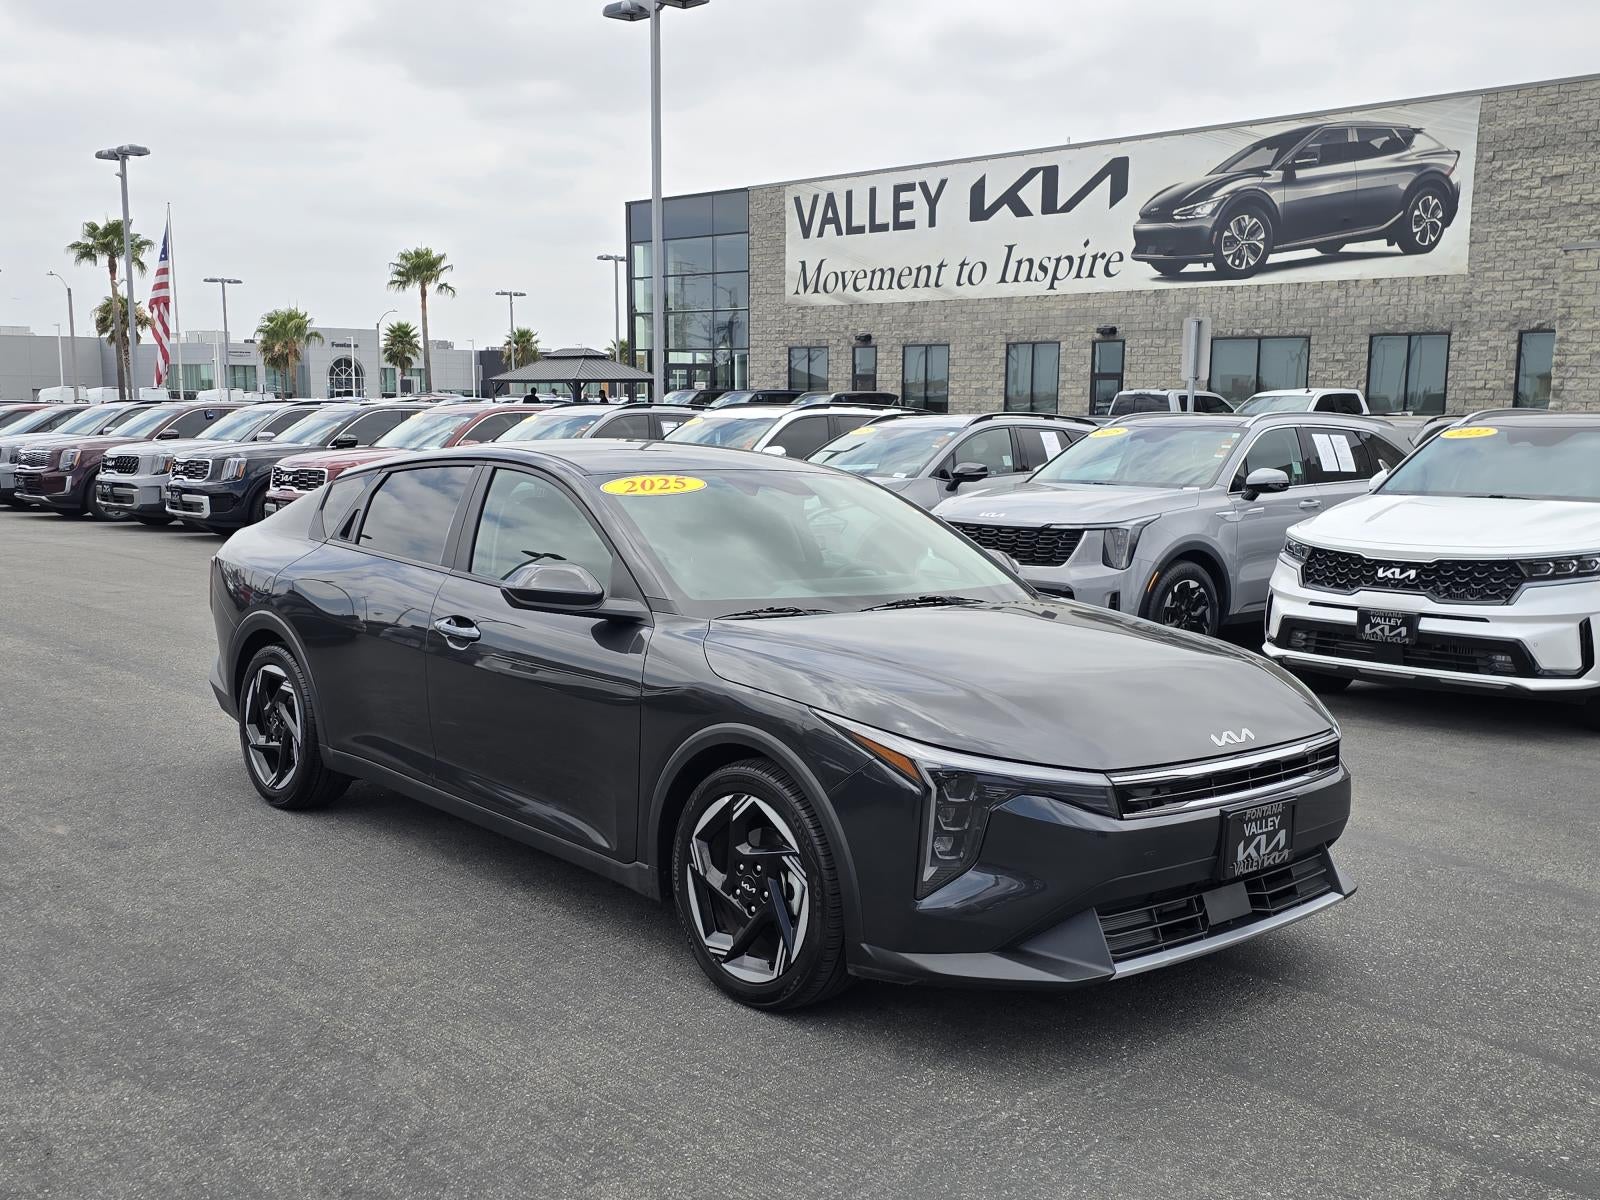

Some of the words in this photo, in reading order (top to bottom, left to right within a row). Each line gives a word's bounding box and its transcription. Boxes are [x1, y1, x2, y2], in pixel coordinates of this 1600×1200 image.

[793, 177, 949, 240] VALLEY
[792, 258, 949, 296] Movement
[955, 255, 988, 287] to
[996, 238, 1125, 291] Inspire
[331, 341, 359, 349] Fontaa
[623, 477, 688, 494] 2025
[1377, 566, 1417, 580] KIA
[1370, 615, 1403, 626] VALLEY
[1361, 632, 1388, 642] VALLEY
[1210, 727, 1255, 747] KIA
[1244, 802, 1284, 821] FONTANA
[1243, 816, 1281, 837] VALLEY
[1232, 854, 1264, 877] VALLEY
